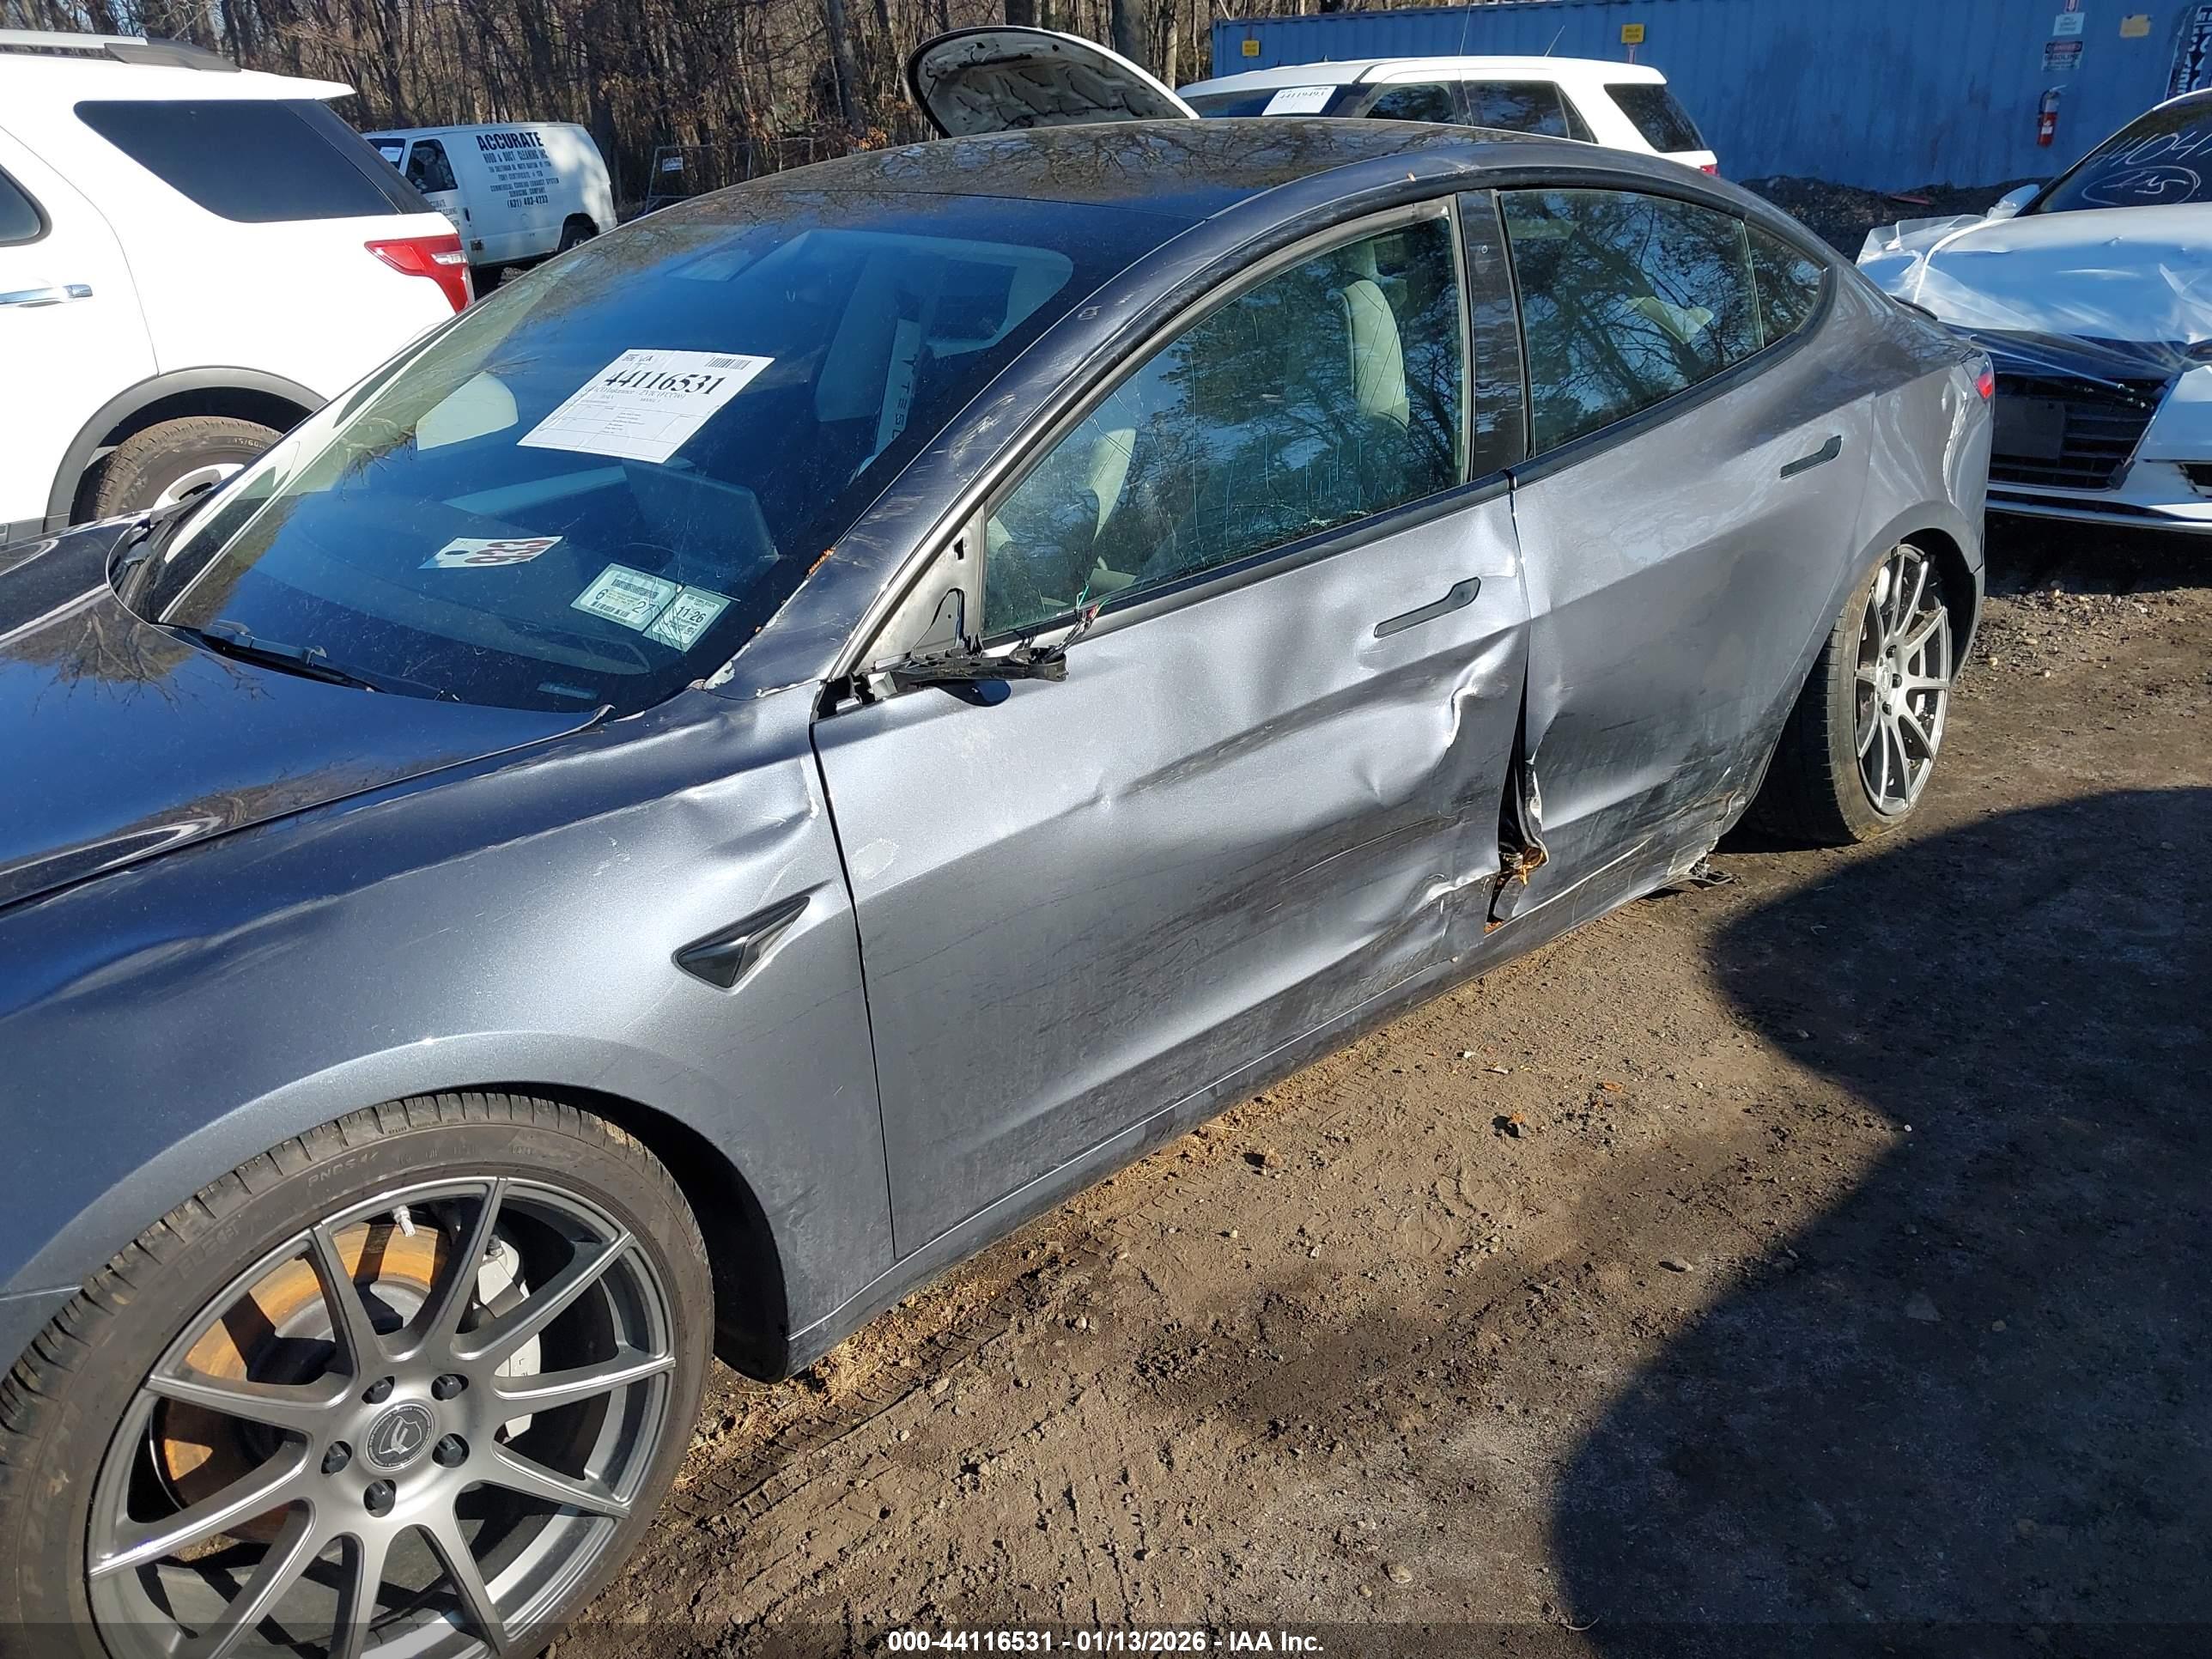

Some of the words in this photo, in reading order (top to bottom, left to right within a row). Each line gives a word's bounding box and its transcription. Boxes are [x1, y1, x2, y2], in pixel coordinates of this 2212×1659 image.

[476, 131, 544, 151] ACCURATE
[605, 369, 726, 394] 44116531
[891, 380, 911, 440] TESL
[595, 588, 609, 600] 6
[631, 600, 656, 616] 27
